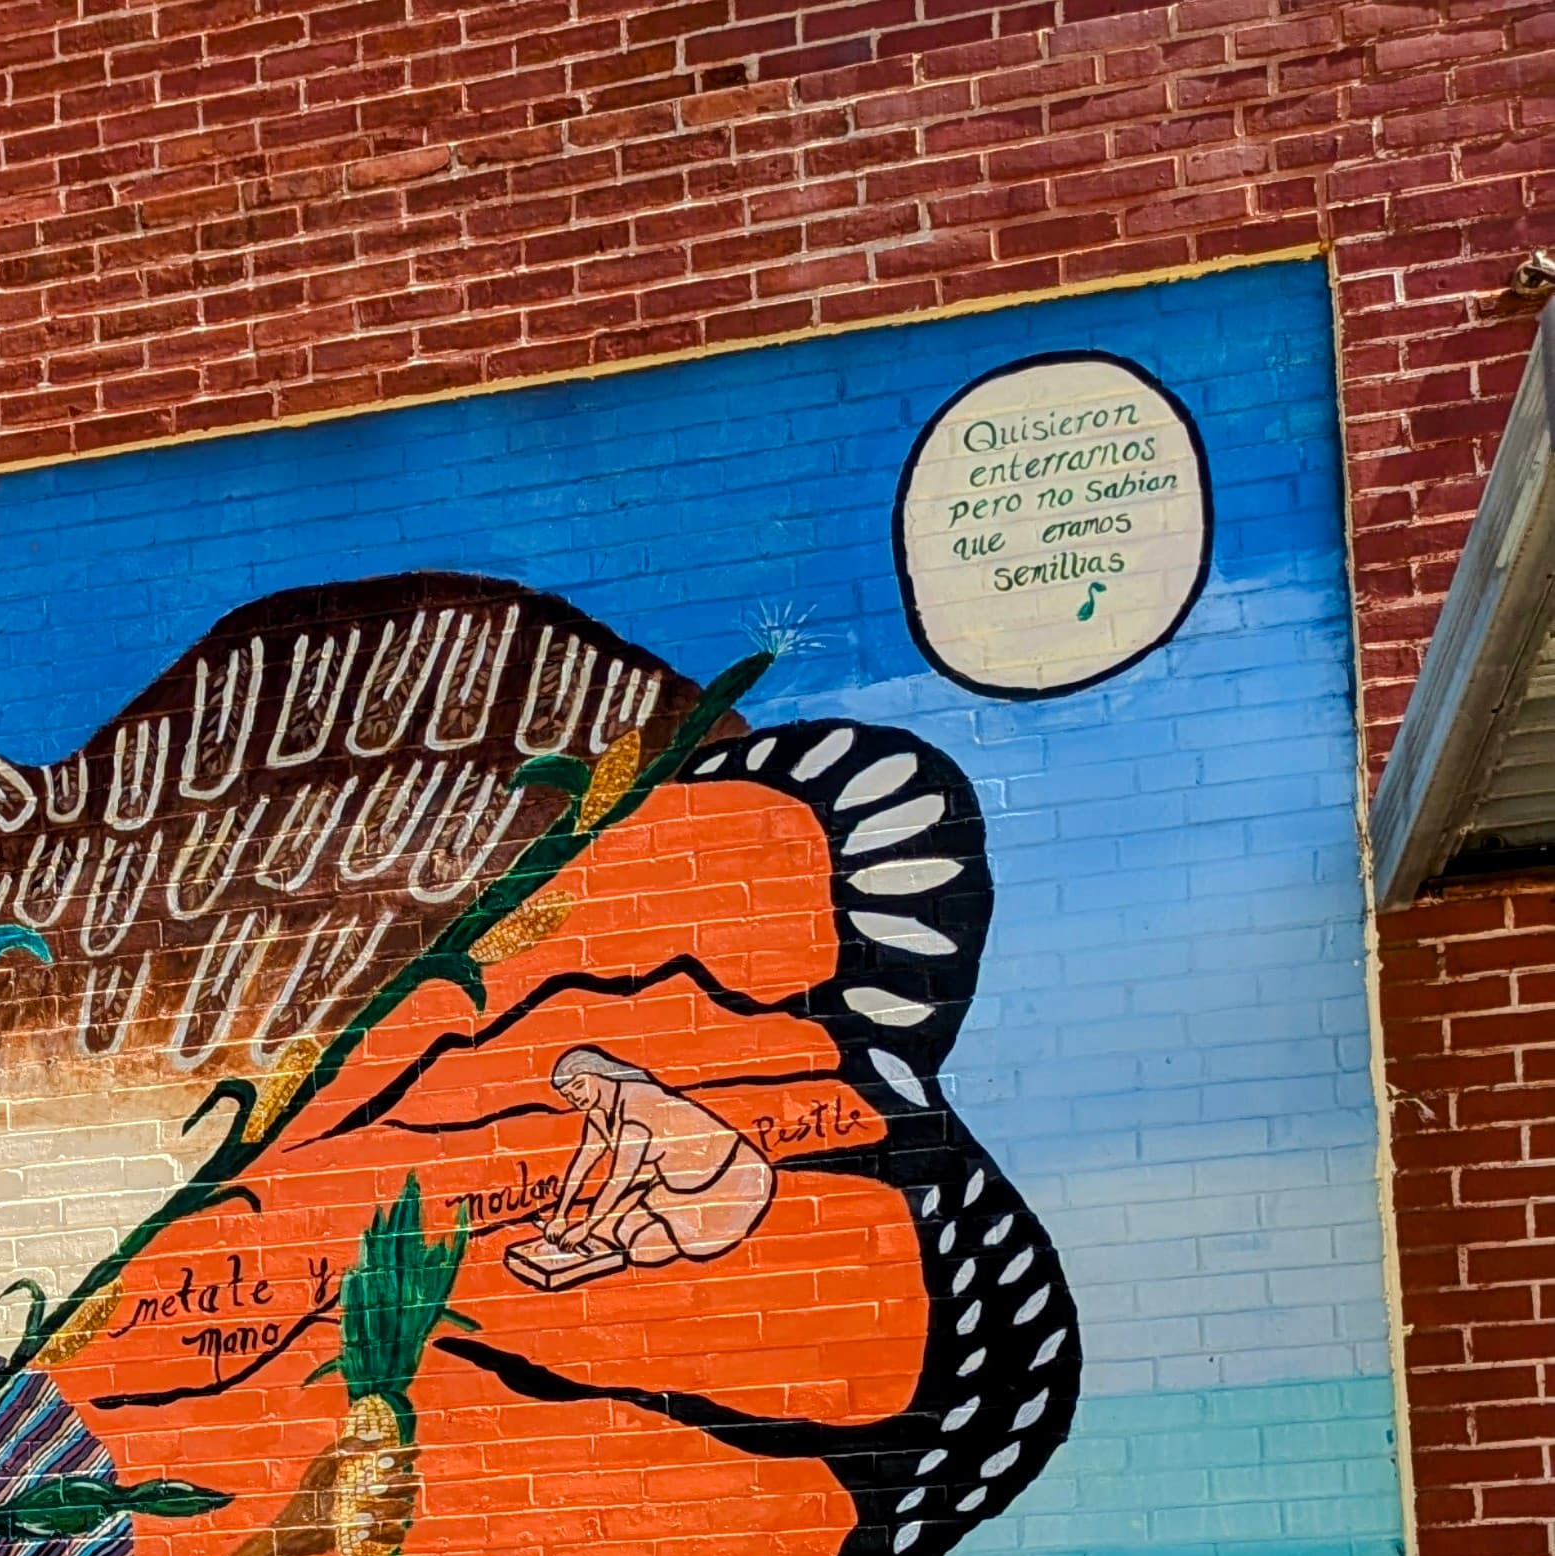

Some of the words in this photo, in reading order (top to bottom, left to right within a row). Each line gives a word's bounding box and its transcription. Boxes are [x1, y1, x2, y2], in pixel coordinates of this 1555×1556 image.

[963, 403, 1140, 453] Quisieron
[970, 436, 1156, 488] enterrarnos
[948, 493, 1022, 529] pero
[1037, 488, 1073, 510] no
[953, 531, 1006, 561] que
[1041, 513, 1133, 545] eramos
[108, 1255, 274, 1338] metate
[182, 1323, 282, 1357] mano
